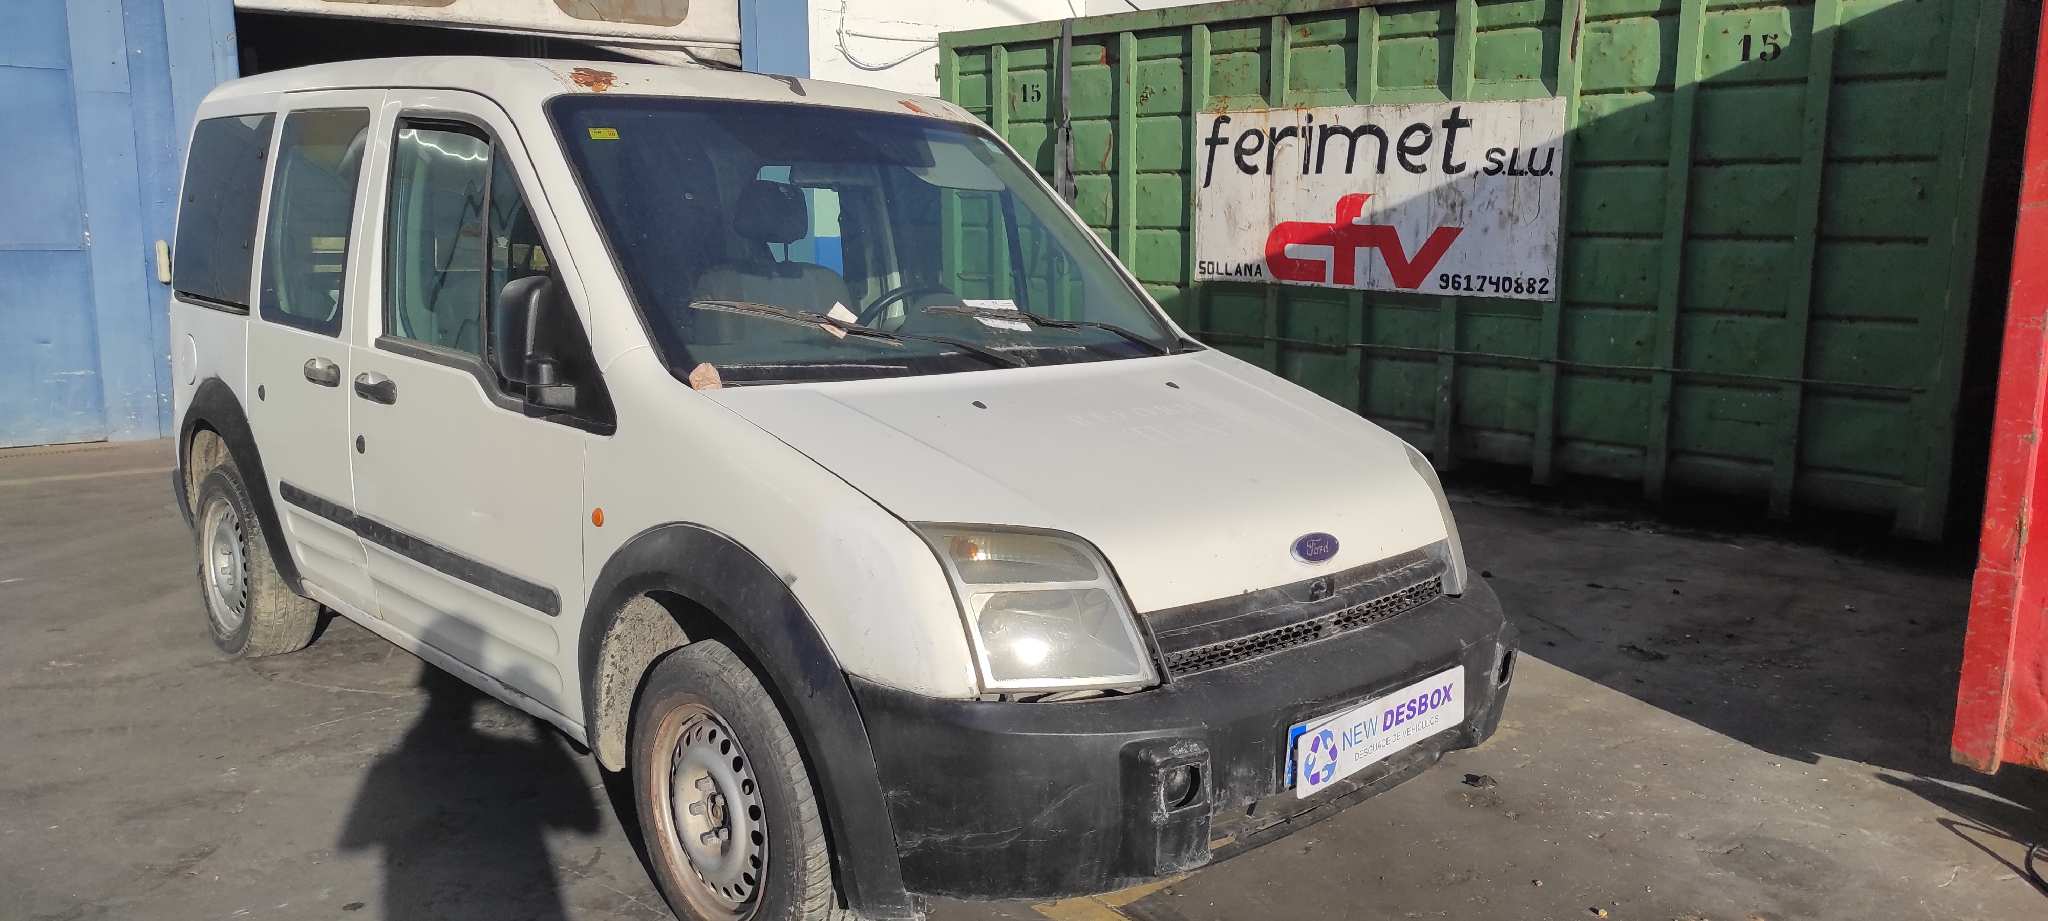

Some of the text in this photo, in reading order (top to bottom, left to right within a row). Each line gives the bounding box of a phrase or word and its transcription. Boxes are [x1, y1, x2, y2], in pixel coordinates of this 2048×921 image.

[1738, 34, 1781, 62] 15
[1022, 83, 1041, 103] 15
[1203, 106, 1473, 188] ferimet
[1198, 260, 1263, 278] SOLLANA
[1439, 273, 1550, 295] 961740882
[1306, 539, 1329, 556] Ford
[1342, 683, 1454, 751] NEW DESBOX
